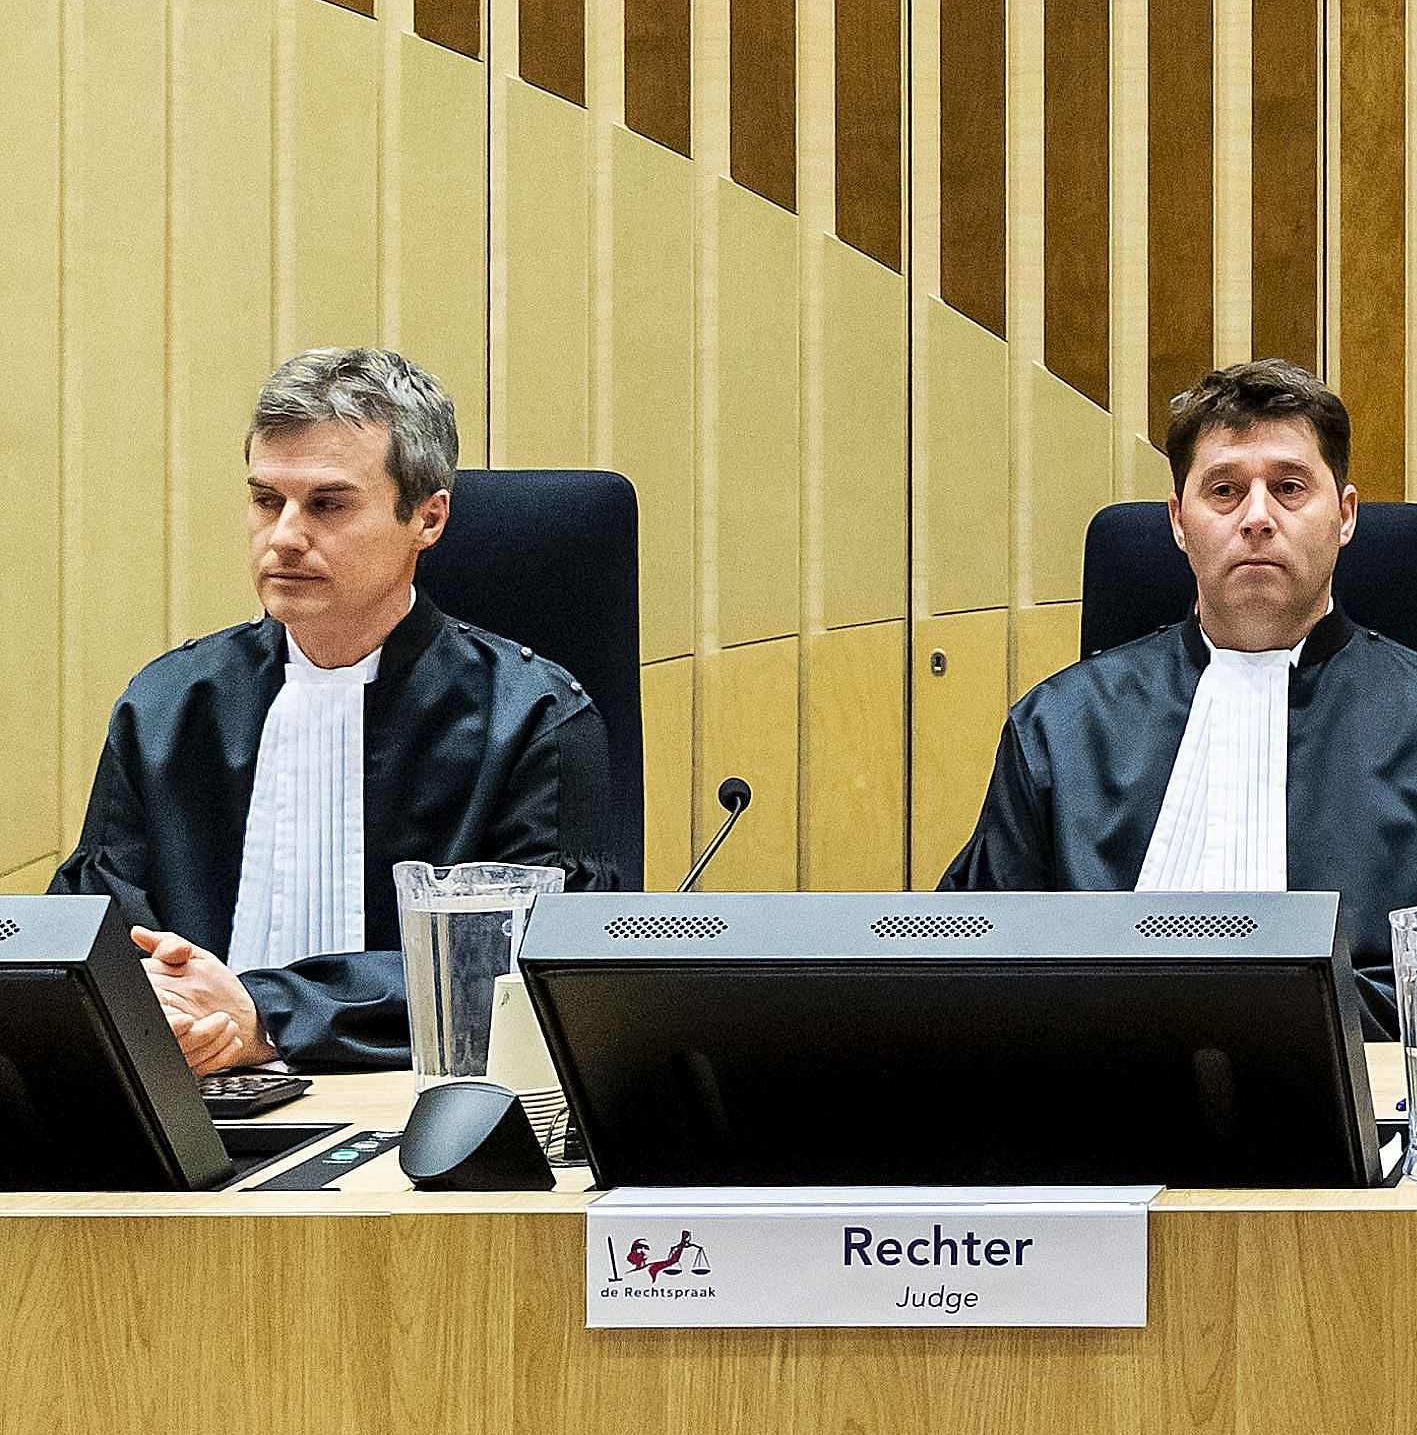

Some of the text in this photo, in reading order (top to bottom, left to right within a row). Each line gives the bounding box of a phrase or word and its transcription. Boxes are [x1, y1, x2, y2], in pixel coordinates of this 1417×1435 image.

[845, 1226, 1034, 1267] Rechter
[601, 1287, 717, 1301] de Rechtspraak
[897, 1286, 979, 1315] Judge
